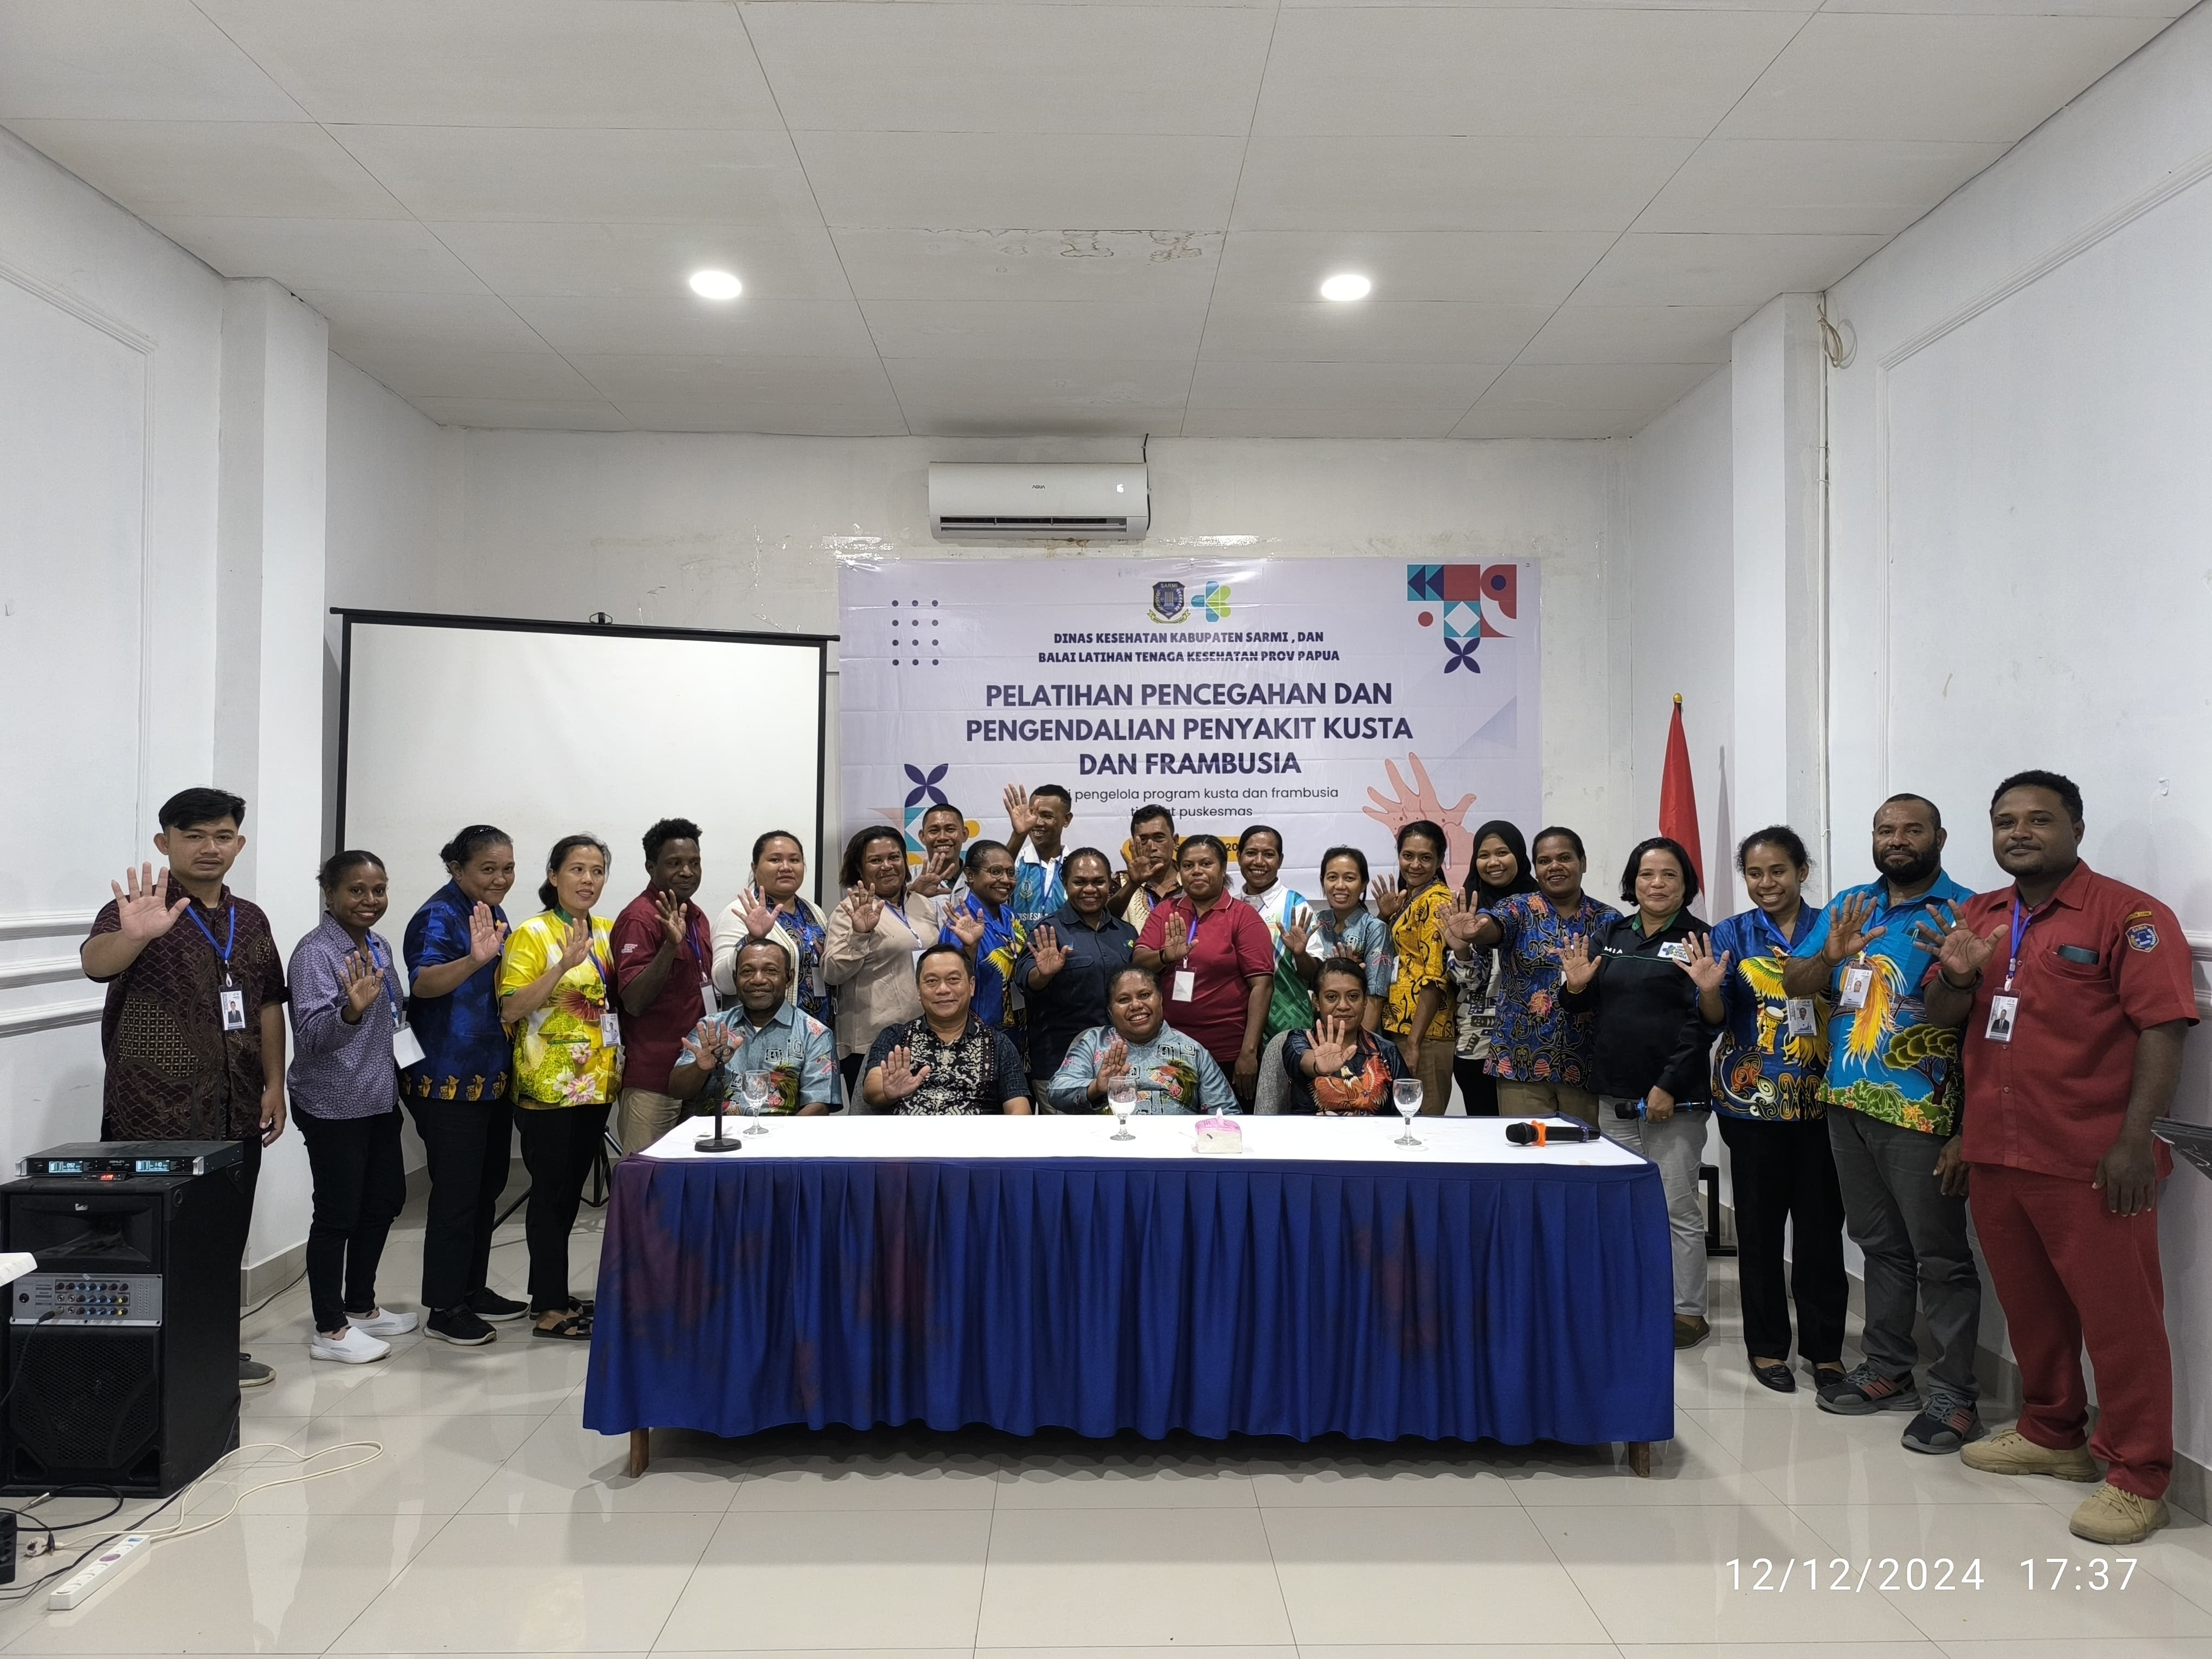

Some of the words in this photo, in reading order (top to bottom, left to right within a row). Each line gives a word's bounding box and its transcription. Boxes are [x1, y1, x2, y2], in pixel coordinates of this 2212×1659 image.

[1054, 633, 1093, 644] DINAS
[1096, 633, 1167, 644] KESEHATAN
[1171, 632, 1243, 643] KABUPATEN
[1246, 632, 1288, 642] SARMI
[1298, 631, 1324, 642] DAN
[1038, 652, 1076, 663] BALAI
[1079, 652, 1133, 663] LATIHAN
[1135, 651, 1185, 662] TENAGA
[1187, 651, 1258, 661] KESEHATAN
[1261, 651, 1295, 661] PROV
[1298, 650, 1340, 661] PAPUA
[986, 684, 1133, 707] PELATIHAN
[1141, 682, 1326, 706] PENCEGAHAN
[1334, 682, 1392, 705] DAN
[967, 718, 1175, 742] PENGENDALIAN
[1184, 717, 1316, 740] PENYAKIT
[1324, 717, 1414, 740] KUSTA
[1079, 753, 1137, 775] DAN
[1146, 751, 1302, 775] FRAMBUSIA
[1075, 788, 1140, 803] pengelola
[1143, 790, 1200, 805] program
[1204, 788, 1239, 799] kusta
[1242, 787, 1268, 799] dan
[1271, 786, 1339, 798] frambusia
[1179, 806, 1253, 820] puskesmas
[1604, 946, 1623, 954] MIA
